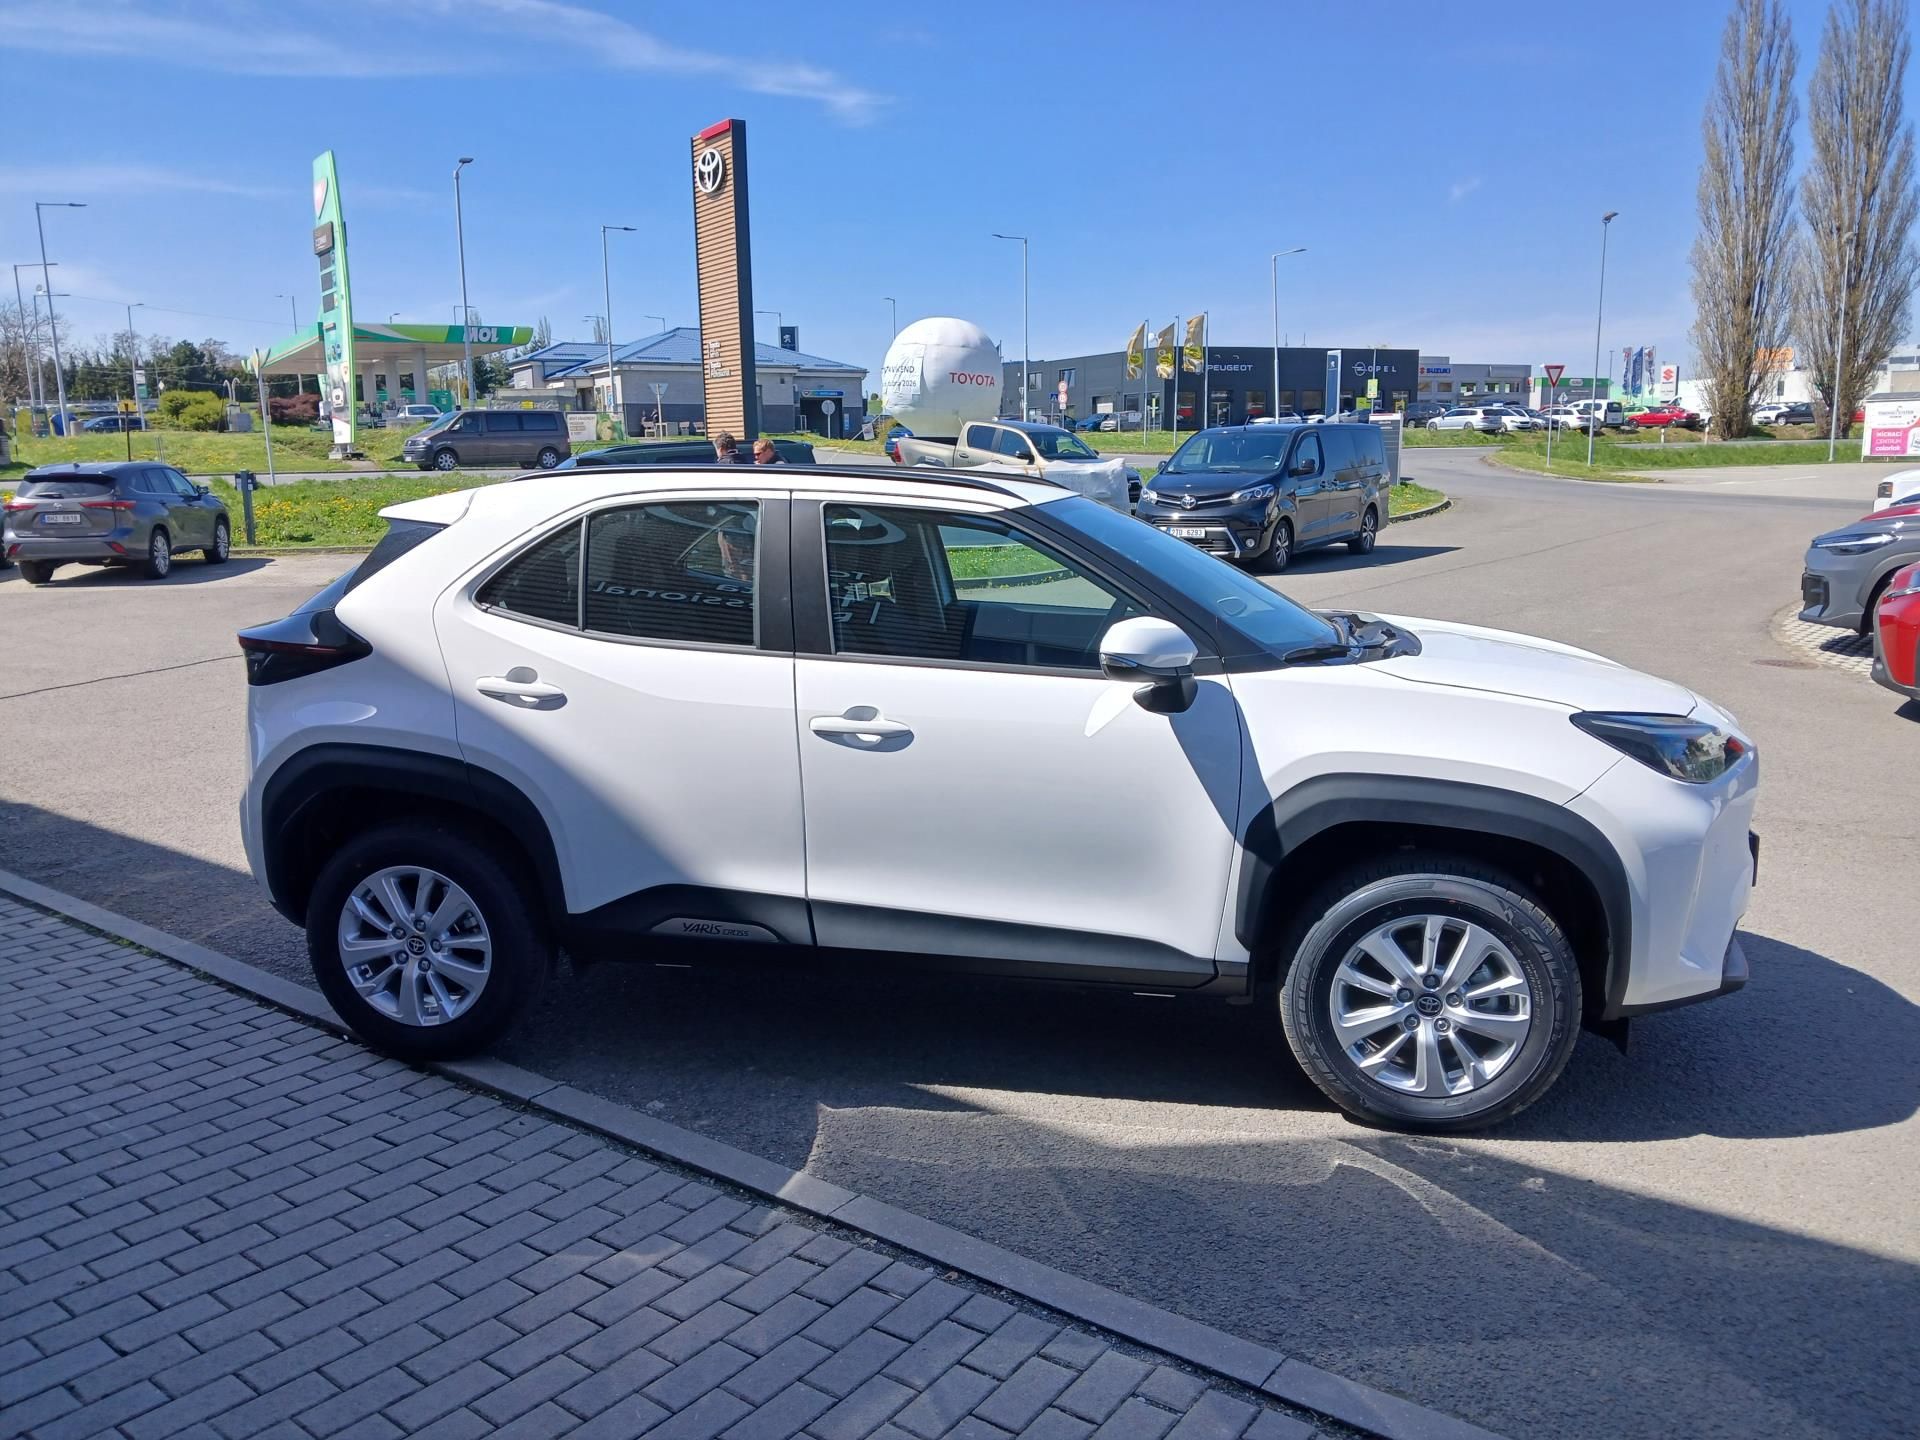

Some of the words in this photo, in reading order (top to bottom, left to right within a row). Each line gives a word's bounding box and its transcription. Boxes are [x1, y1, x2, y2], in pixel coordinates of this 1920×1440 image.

[1367, 365, 1397, 373] OPEL
[949, 372, 995, 387] TOYOTA
[682, 922, 723, 936] YARIS
